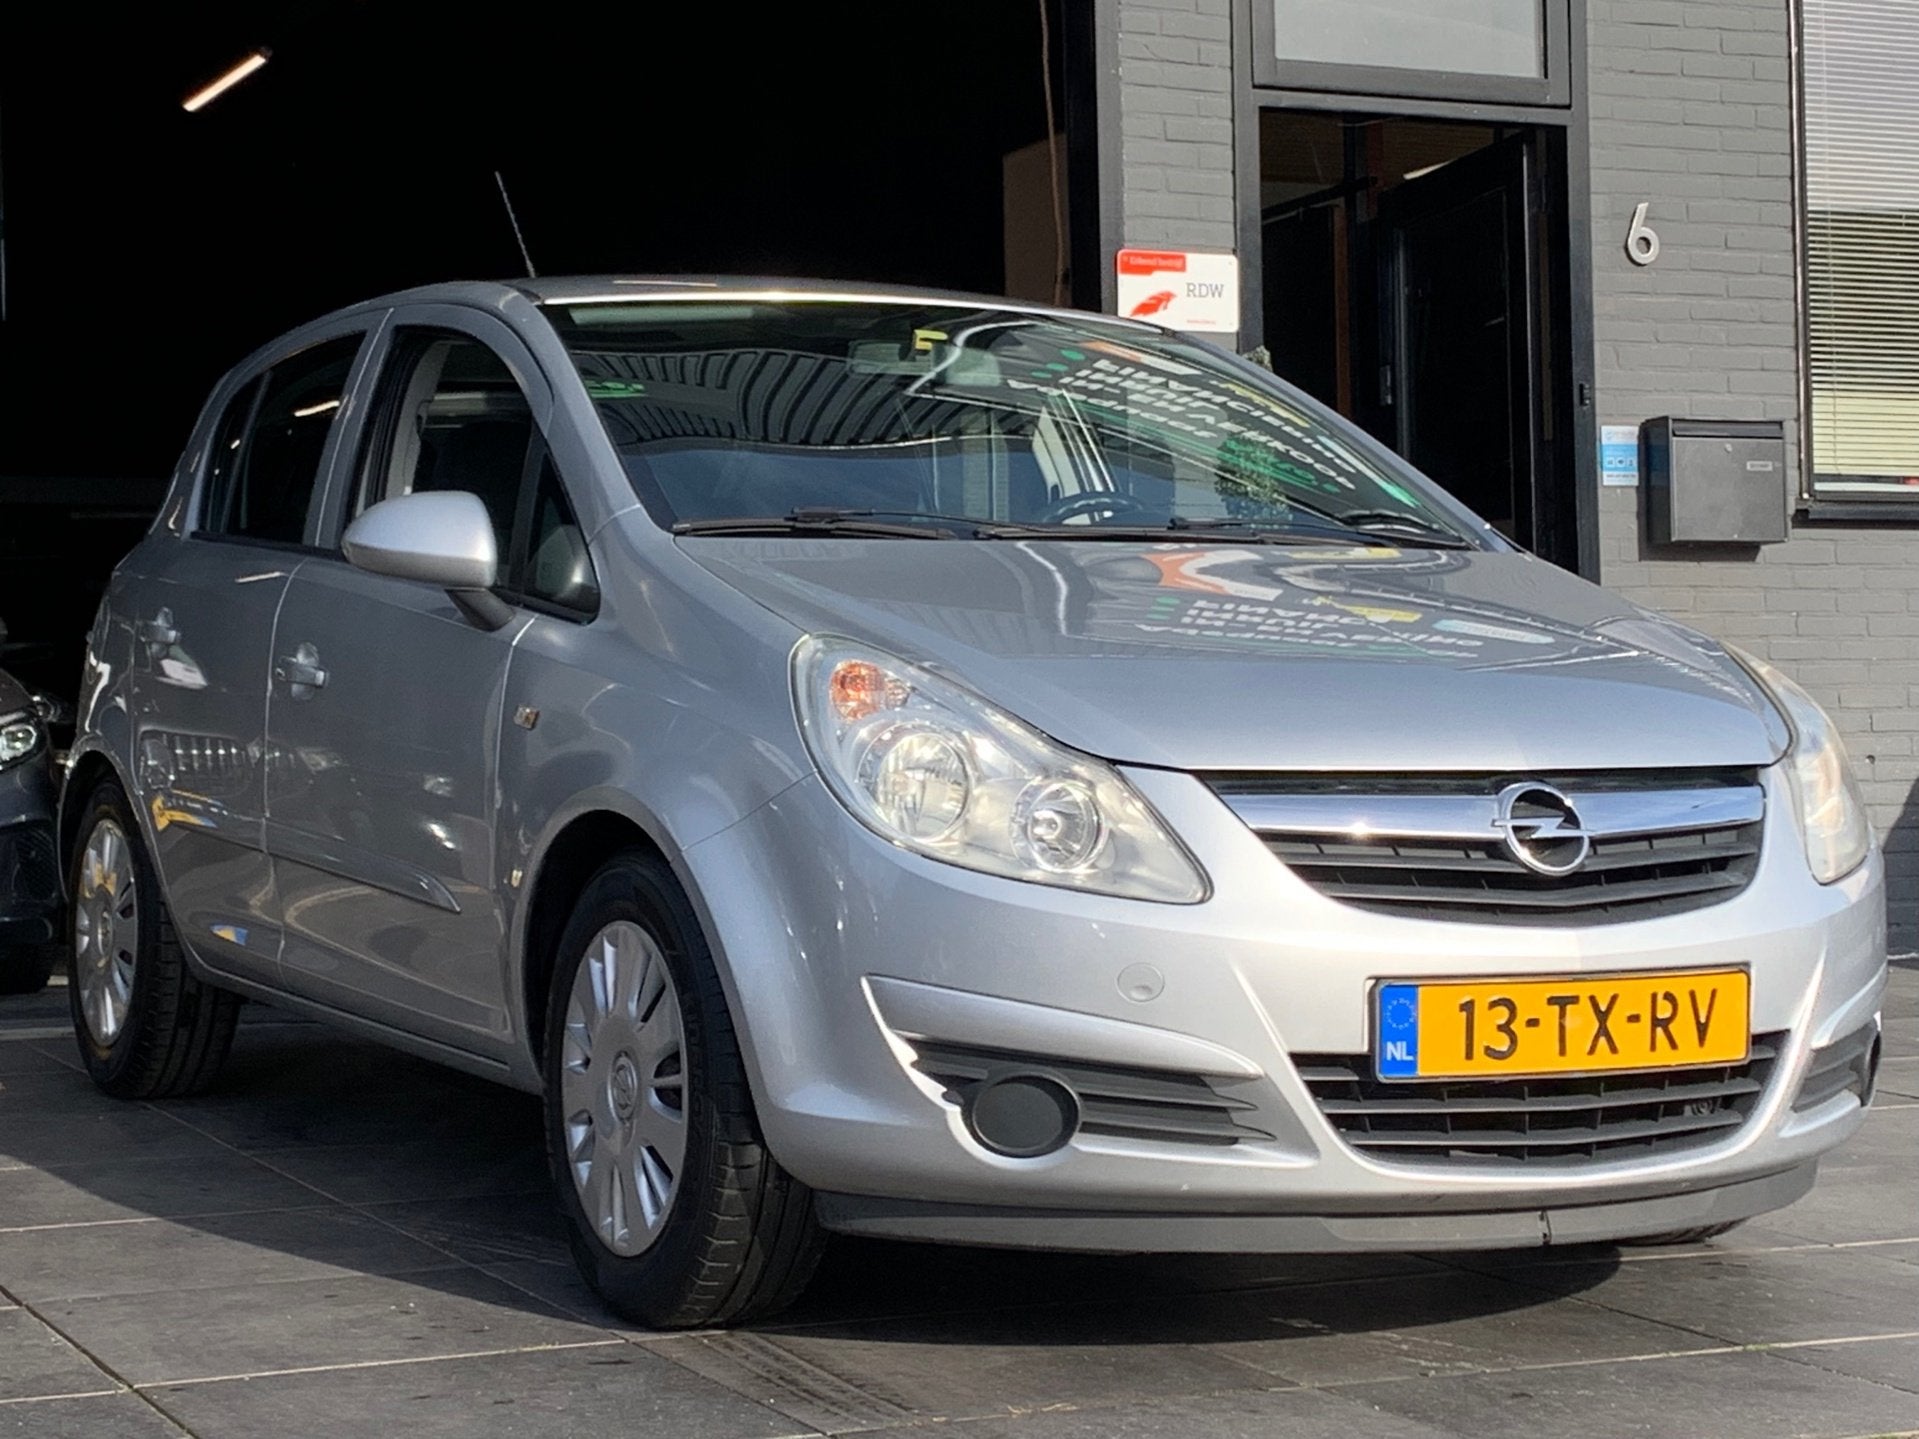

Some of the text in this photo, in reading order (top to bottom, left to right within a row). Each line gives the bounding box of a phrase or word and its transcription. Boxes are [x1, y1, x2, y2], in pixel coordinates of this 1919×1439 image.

[1626, 202, 1660, 266] 6
[1186, 282, 1225, 299] RDW
[1458, 988, 1718, 1062] 13-TX-RV
[1386, 1041, 1414, 1061] NL
